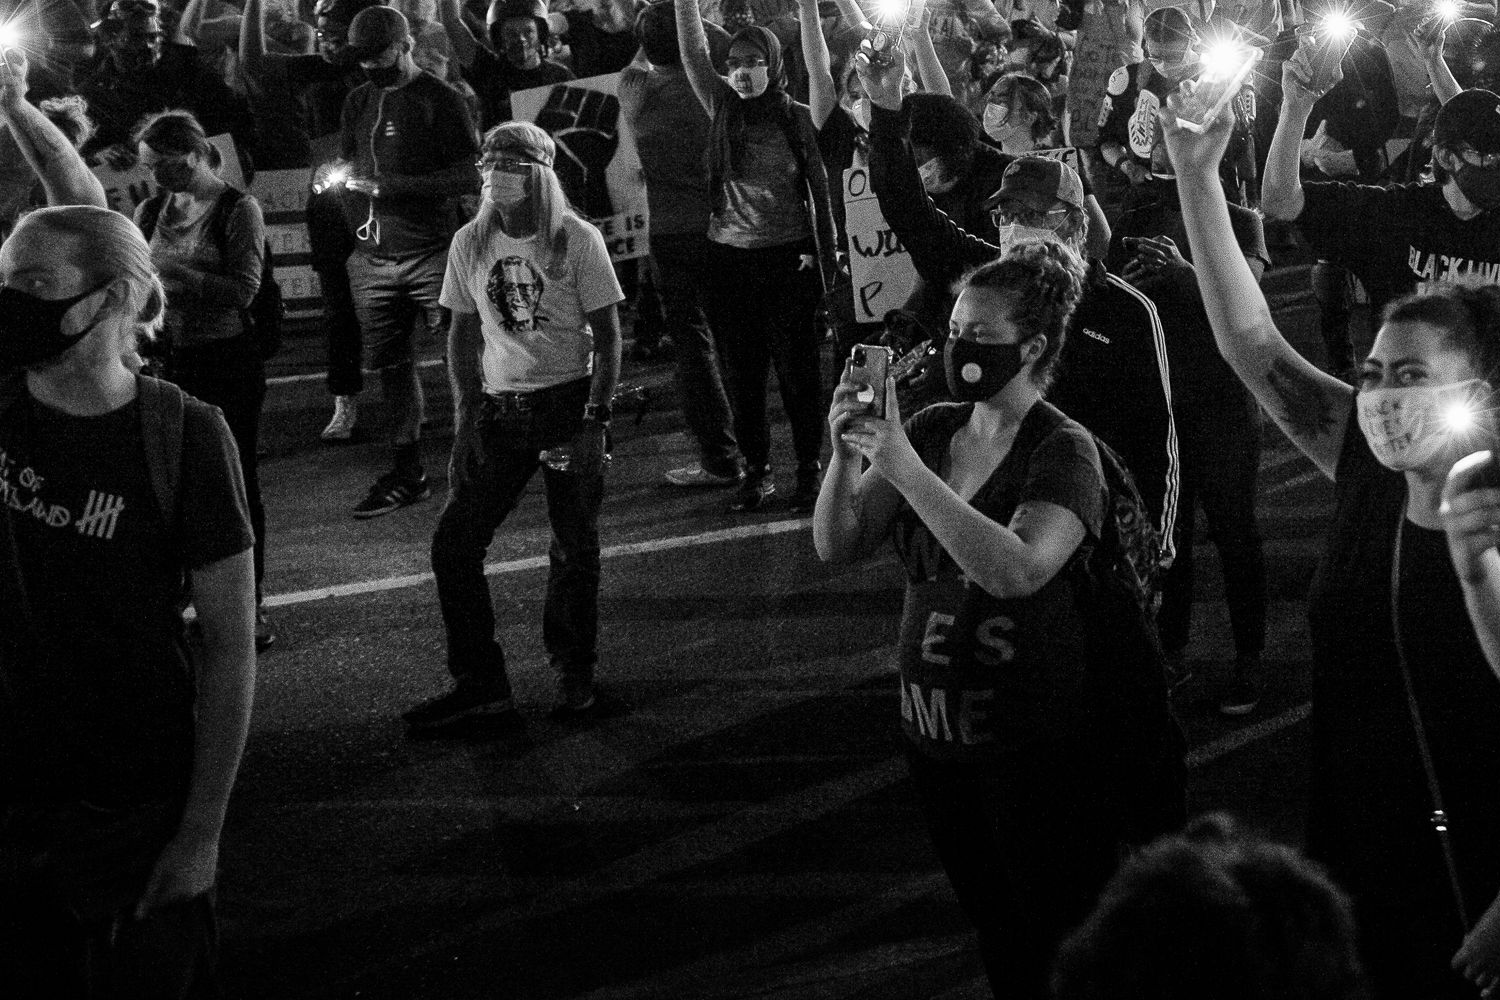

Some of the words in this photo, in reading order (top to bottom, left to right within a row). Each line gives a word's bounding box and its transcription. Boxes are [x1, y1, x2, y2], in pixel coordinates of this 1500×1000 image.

[626, 213, 645, 231] IS
[1408, 244, 1464, 281] BLACK
[1082, 327, 1110, 345] adidas
